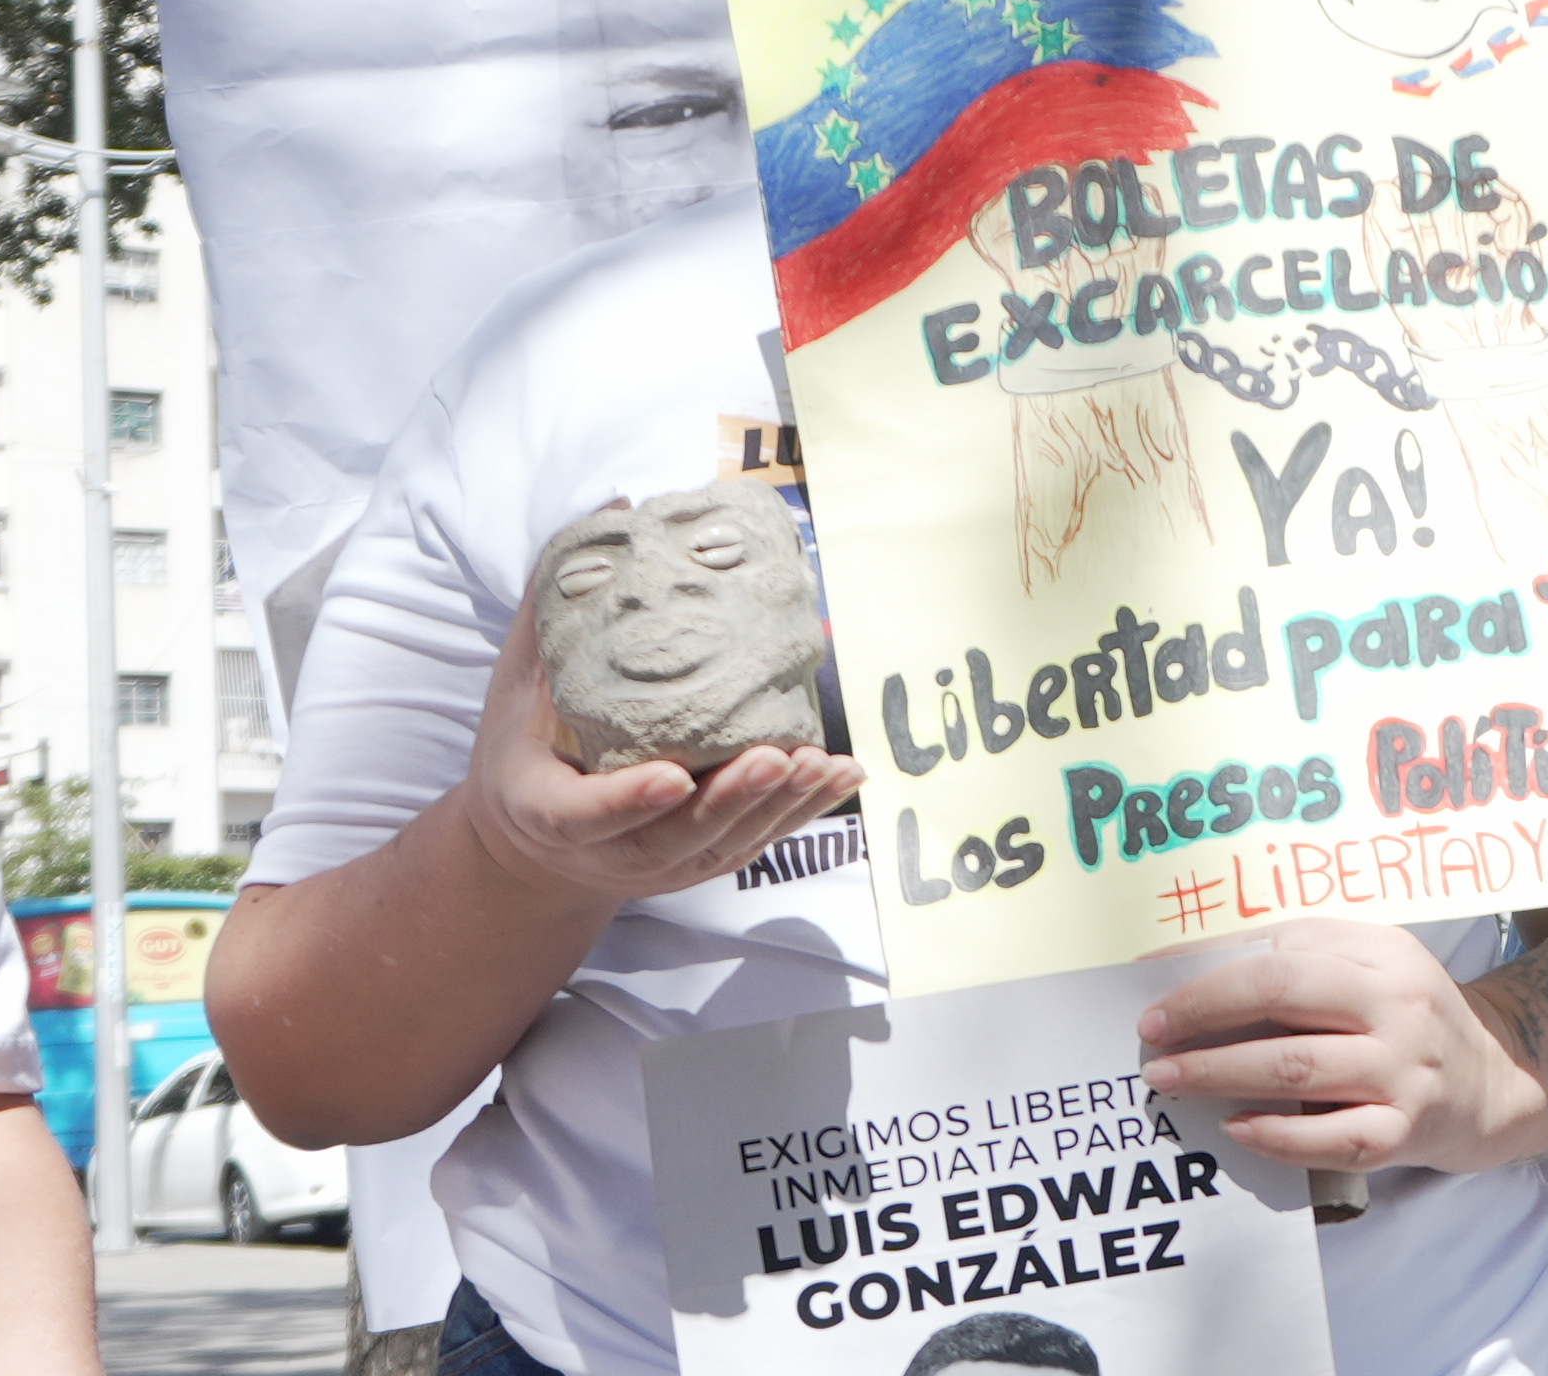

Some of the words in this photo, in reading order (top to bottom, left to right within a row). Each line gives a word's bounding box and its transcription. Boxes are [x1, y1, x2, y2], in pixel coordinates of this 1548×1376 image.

[1006, 133, 1372, 272] BOLETAS
[1392, 131, 1504, 216] DE
[741, 426, 804, 471] LU
[1228, 424, 1438, 567] YA!
[882, 585, 1269, 779] Libertad
[897, 806, 1046, 907] Los
[1064, 752, 1344, 867] Presos
[737, 1101, 969, 1176] EXIGIMOS
[987, 1070, 1180, 1128] LIBERT
[771, 1141, 1042, 1212] INMEDIATA
[1056, 1111, 1182, 1161] PARA
[757, 1200, 922, 1275] LUIS
[945, 1150, 1222, 1240] EDWAR
[795, 1220, 1186, 1331] GONZÁLEZ
